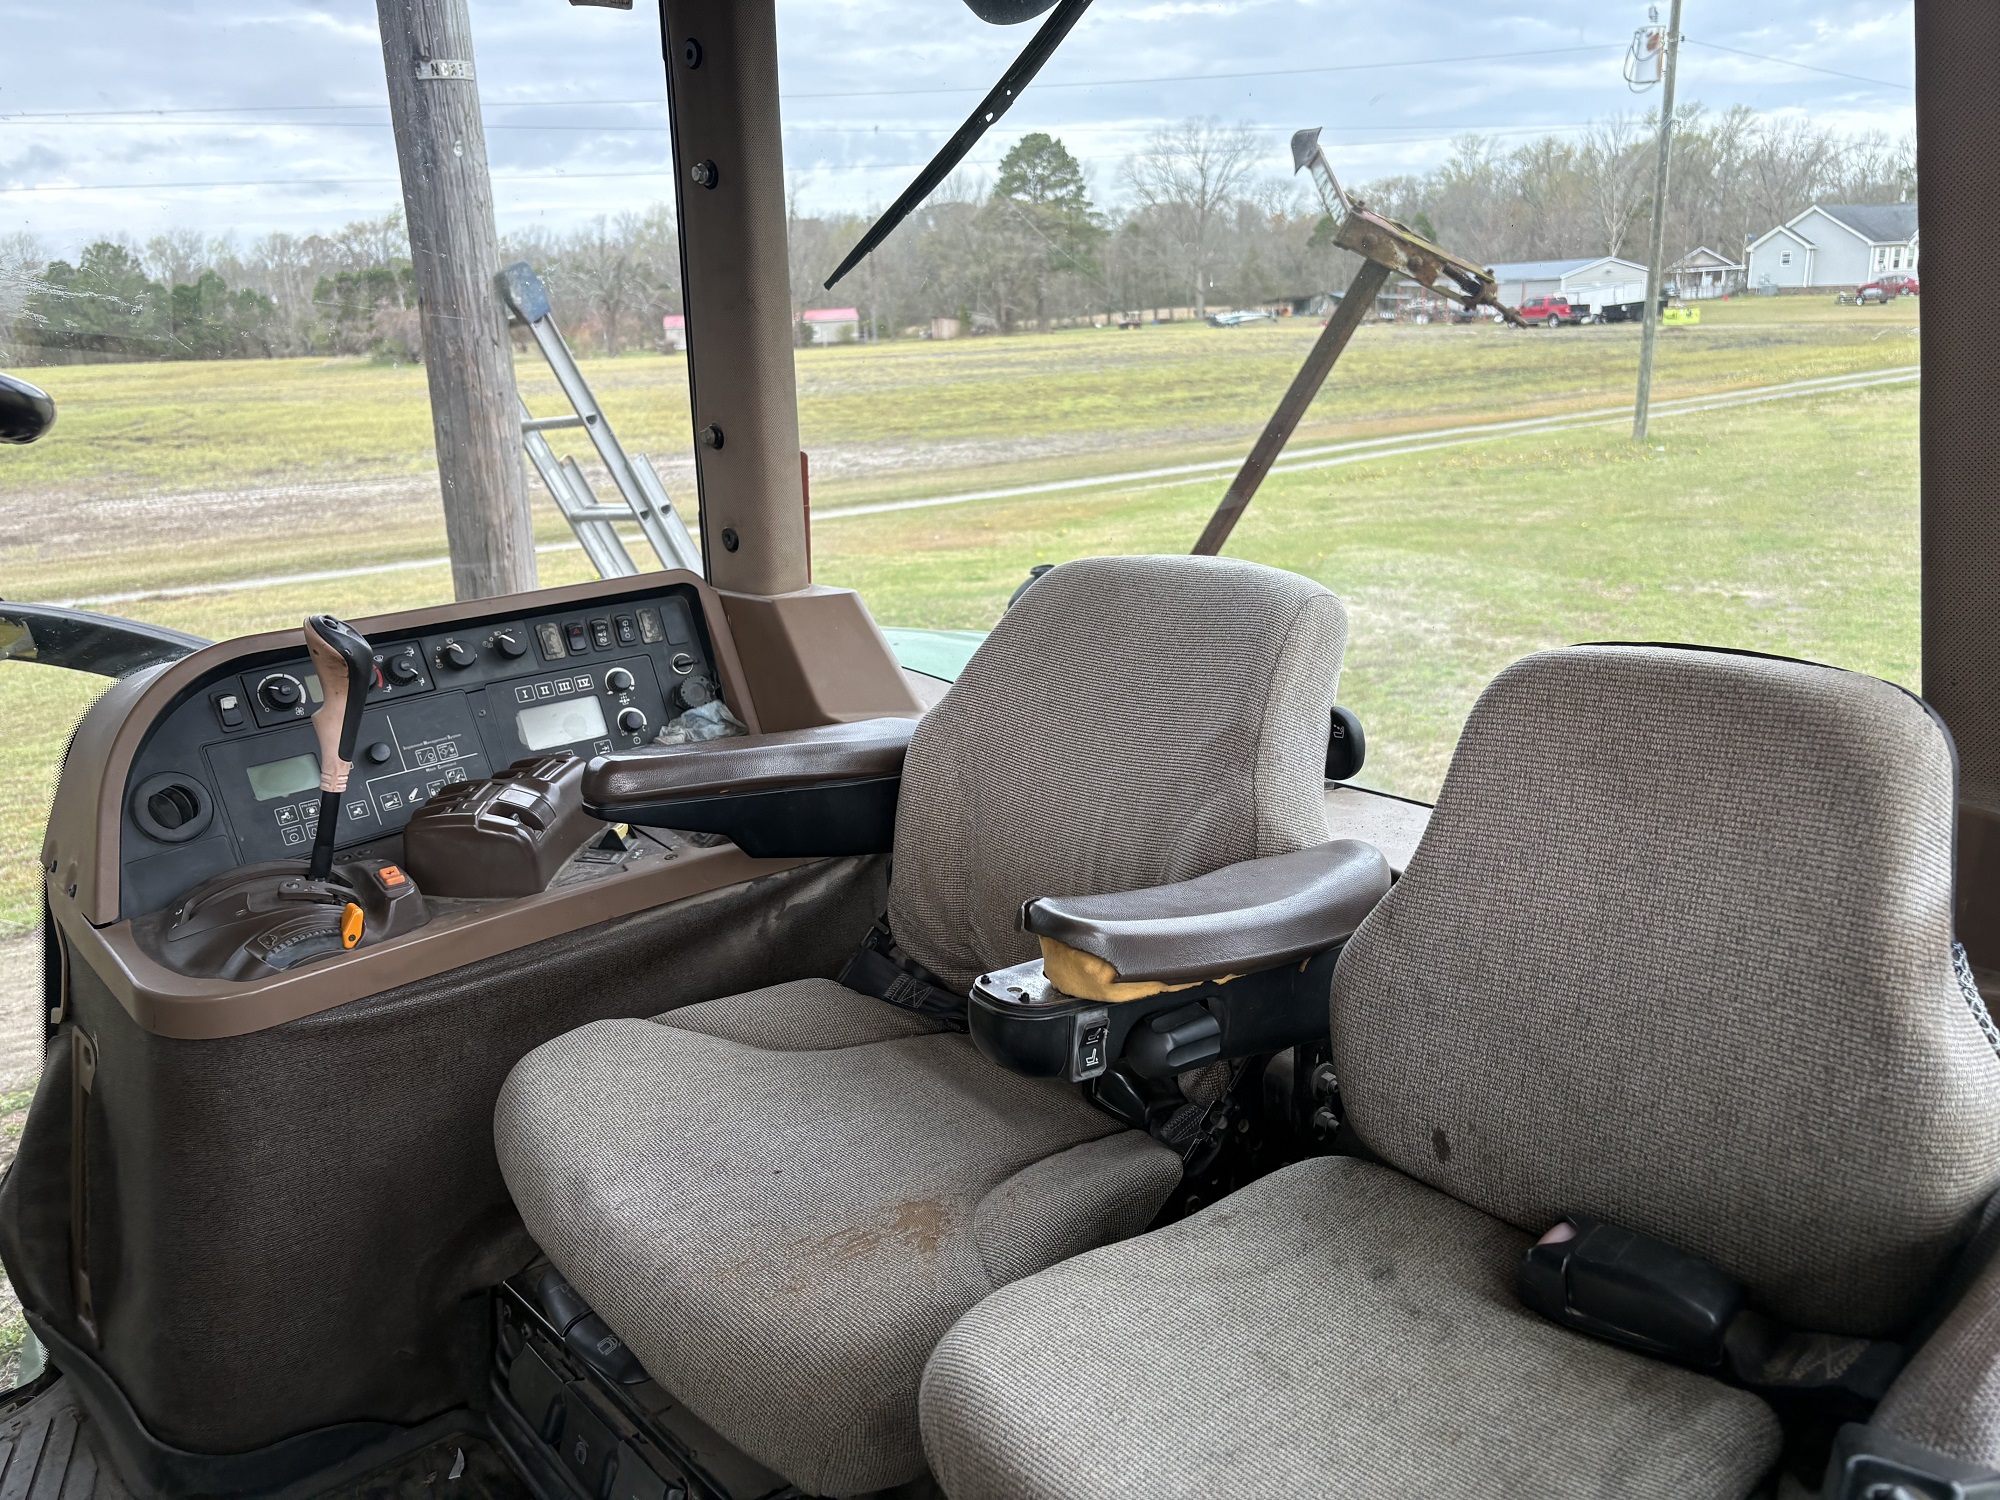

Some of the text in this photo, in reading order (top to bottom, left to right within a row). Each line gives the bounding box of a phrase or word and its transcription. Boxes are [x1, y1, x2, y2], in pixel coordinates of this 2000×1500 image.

[557, 682, 571, 692] III
[577, 678, 591, 688] IV
[522, 690, 529, 699] I
[540, 686, 550, 695] II
